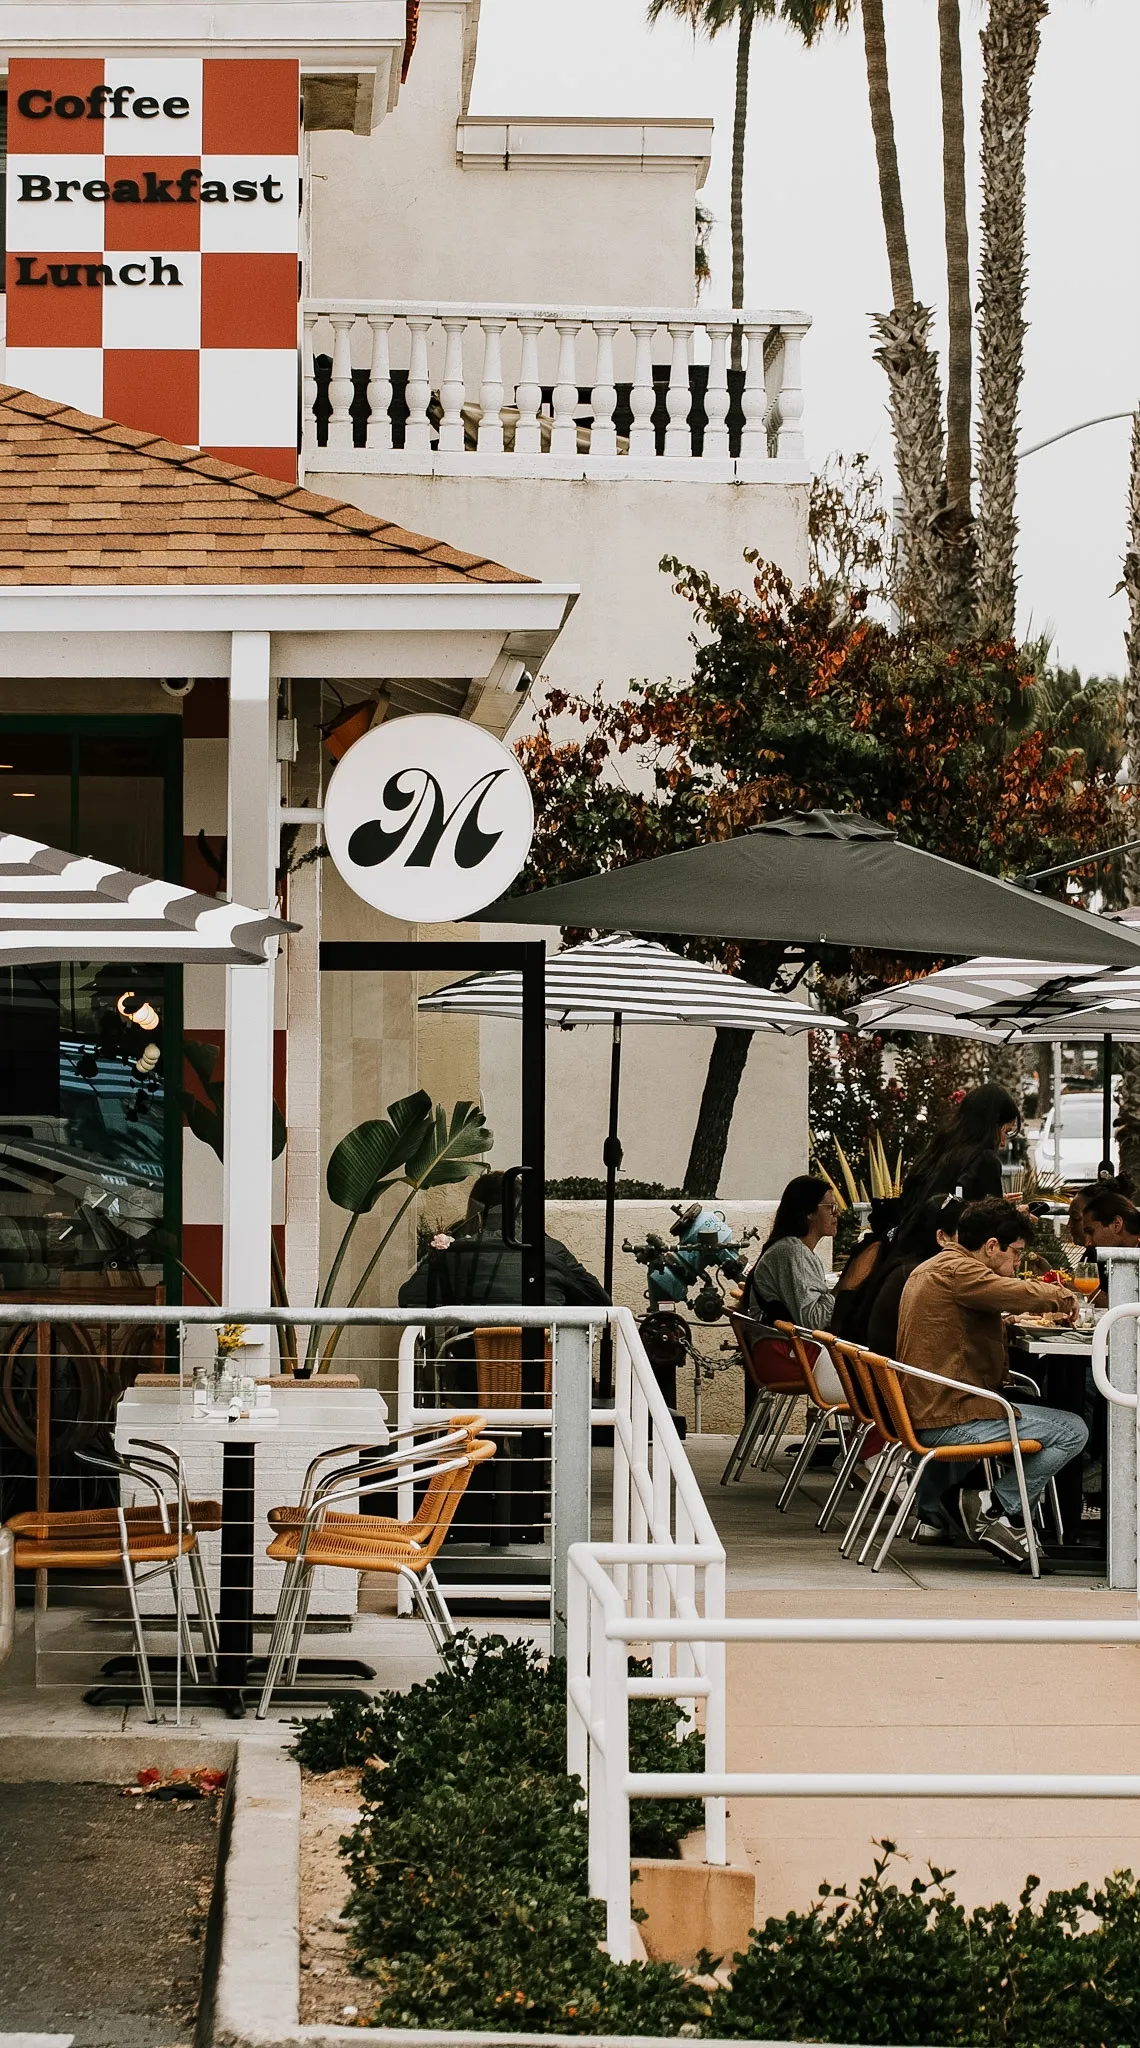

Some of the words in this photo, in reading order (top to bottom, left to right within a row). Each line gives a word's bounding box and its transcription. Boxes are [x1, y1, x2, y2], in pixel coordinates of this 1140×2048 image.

[17, 85, 190, 119] Coffee
[17, 169, 284, 203] Breakfast
[15, 256, 184, 287] Lunch
[347, 767, 511, 869] M
